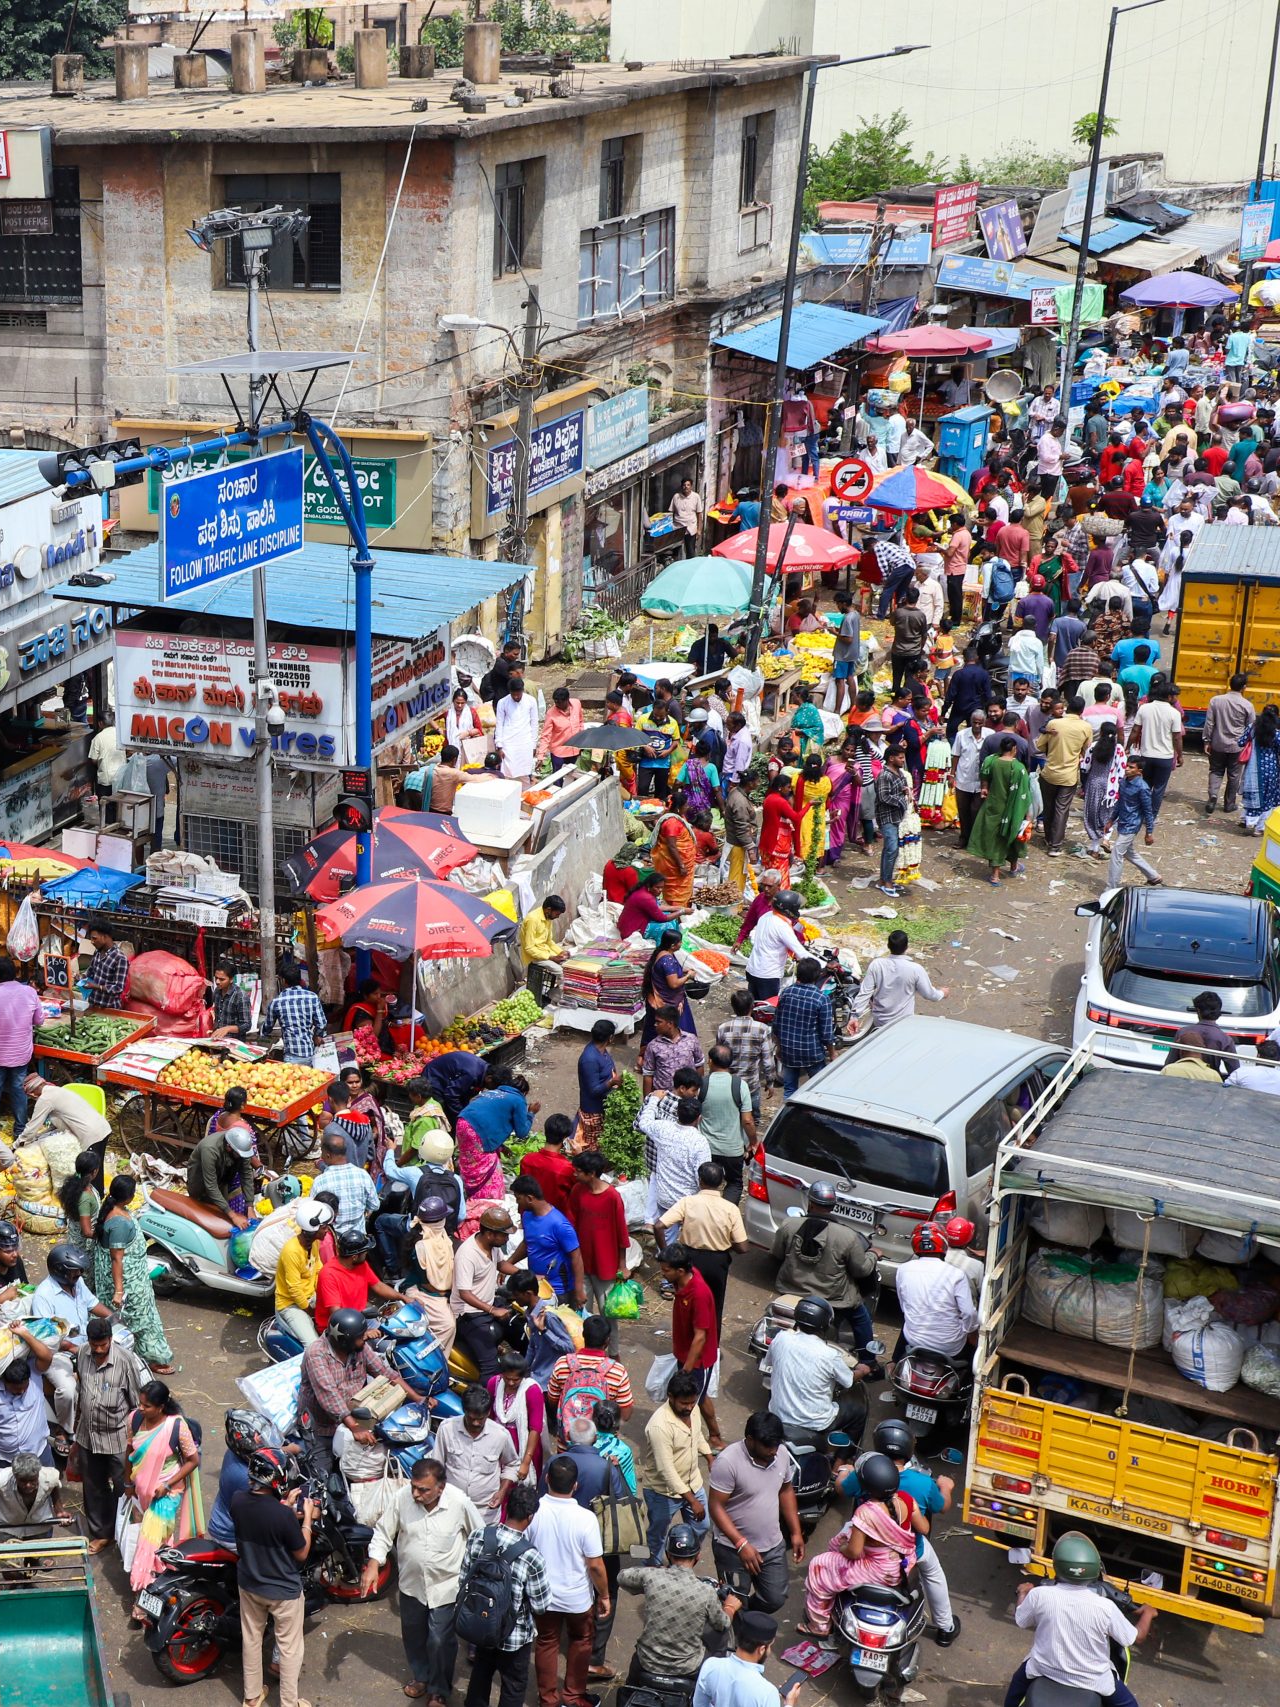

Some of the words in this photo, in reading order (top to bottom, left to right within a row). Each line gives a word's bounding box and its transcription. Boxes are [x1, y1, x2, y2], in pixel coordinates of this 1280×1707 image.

[5, 218, 22, 226] POST
[24, 217, 48, 225] OFFICE
[560, 445, 579, 463] DEPOT
[218, 467, 258, 504] ಸಂಚಾರ
[246, 498, 276, 531] ಪಾಲಿಸಿ
[839, 509, 870, 519] ORBIT
[170, 560, 202, 587] FOLLOW
[204, 552, 237, 574] TRAFFIC
[238, 541, 258, 564] LANE
[259, 524, 300, 554] DISCIPLINE
[164, 660, 187, 669] Market
[187, 662, 207, 671] Police
[208, 664, 231, 673] Station
[164, 671, 184, 679] Market
[409, 678, 451, 718] wires
[130, 713, 232, 746] MICON
[285, 752, 307, 761] Fencing
[434, 843, 457, 865] DIRECT
[336, 906, 355, 920] DIRECT
[367, 923, 407, 935] DIRECT
[428, 925, 466, 935] DIRECT
[47, 968, 68, 985] 20
[1131, 1456, 1139, 1466] K
[1210, 1476, 1261, 1497] HORN
[1194, 1573, 1259, 1600] KA-40-B-0629
[863, 1650, 884, 1662] KA03
